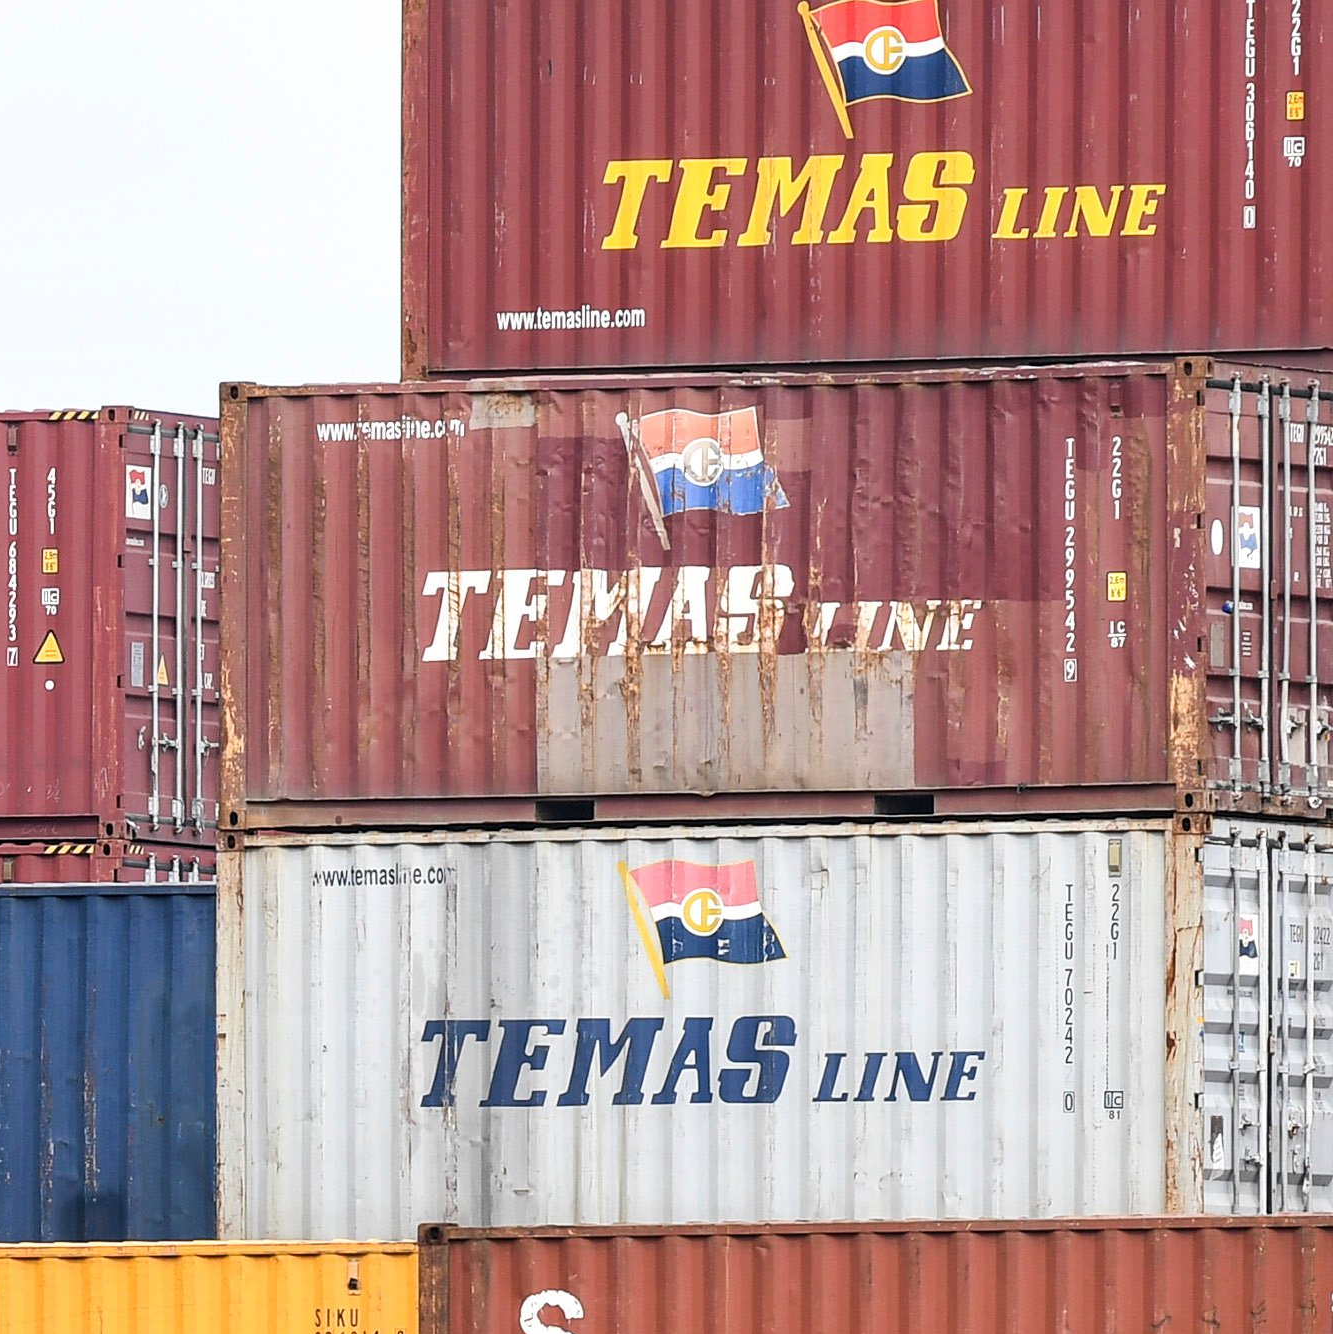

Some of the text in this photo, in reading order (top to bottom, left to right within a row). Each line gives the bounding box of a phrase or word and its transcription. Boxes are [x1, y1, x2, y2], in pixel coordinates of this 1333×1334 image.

[1290, 0, 1301, 76] 22G1
[1244, 82, 1256, 200] 306140
[1288, 157, 1302, 168] 70
[601, 151, 1167, 250] TEMAS LINE
[1244, 206, 1256, 229] 0
[496, 305, 646, 331] www.temasline.com
[46, 467, 56, 534] 45G1
[1112, 436, 1122, 520] 22G1
[7, 468, 18, 666] TEGU 684293 7
[1064, 437, 1077, 682] TEGU 299542 9
[45, 606, 57, 615] 70
[422, 564, 796, 662] TEMAS
[1112, 637, 1125, 648] 87
[1064, 884, 1073, 960] TEGU
[1110, 884, 1120, 960] 22G1
[420, 1015, 985, 1108] TEMAS LINE
[1065, 1093, 1073, 1112] 0
[1108, 1111, 1121, 1121] 81
[314, 1308, 359, 1328] SIKU
